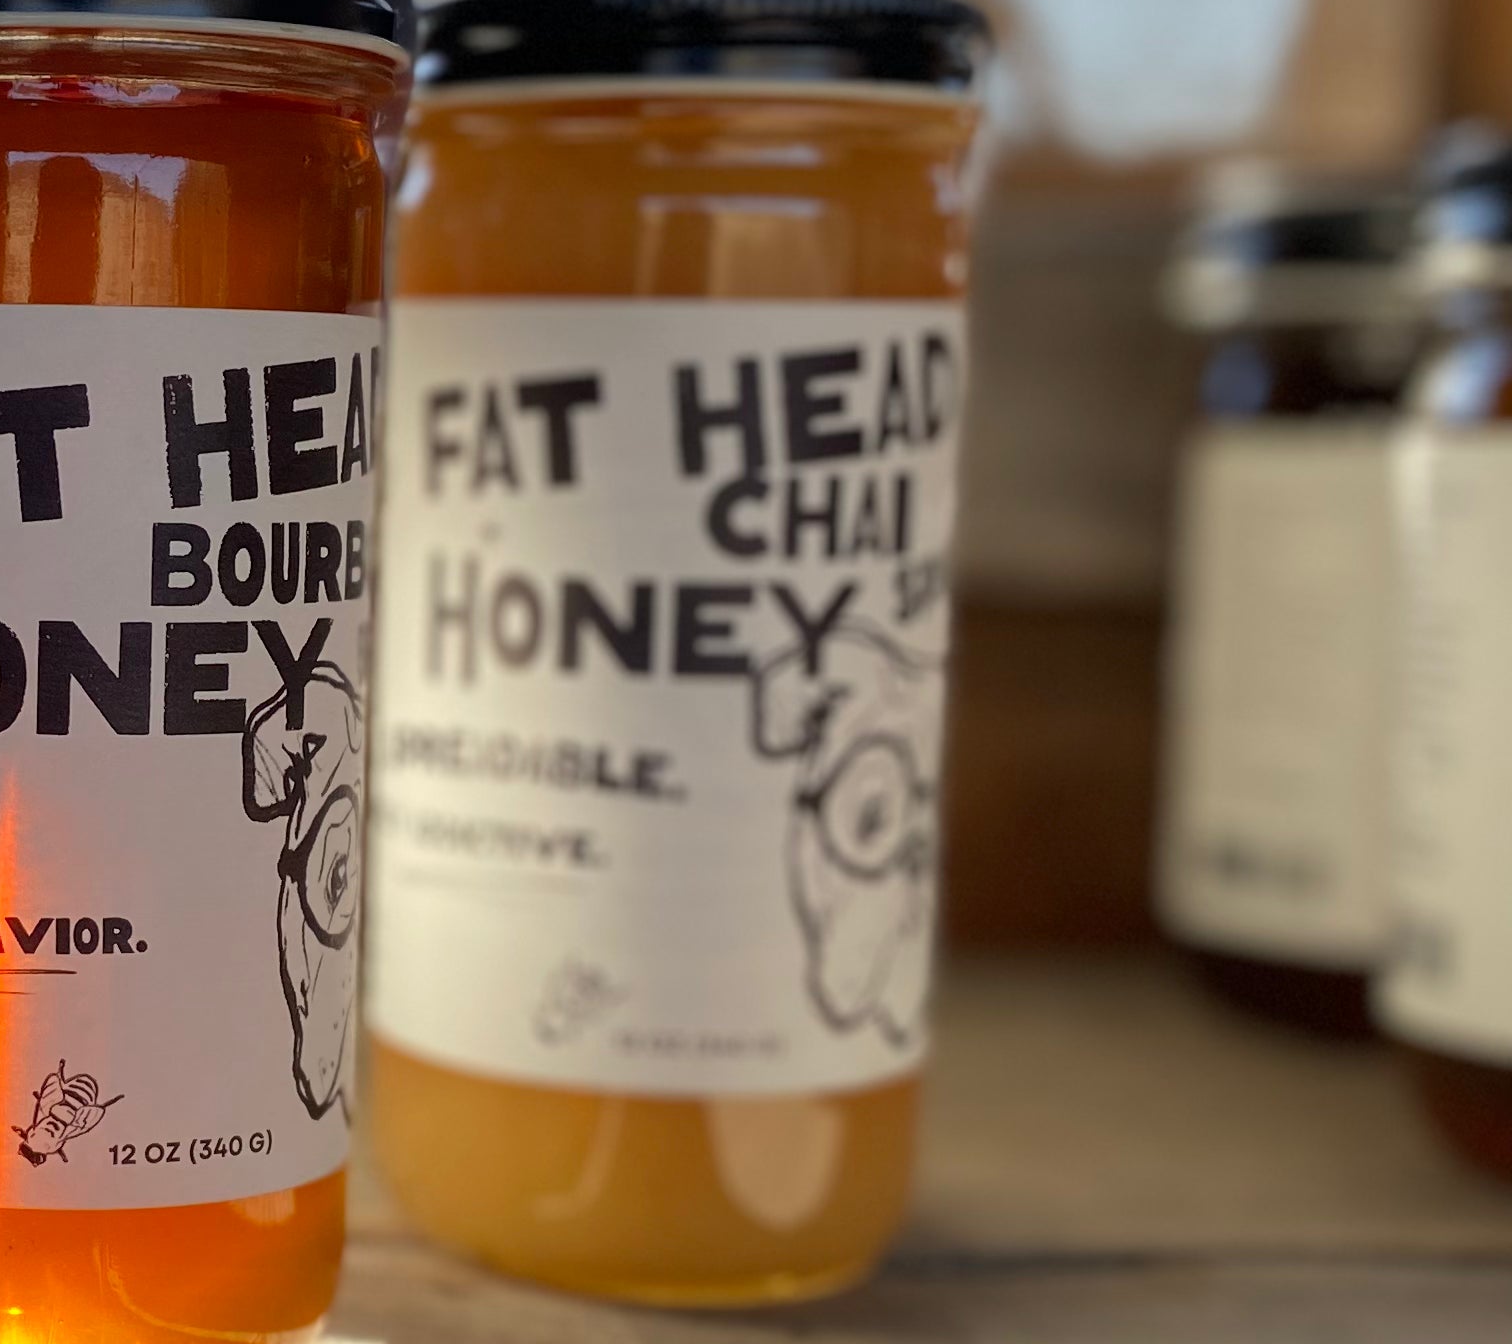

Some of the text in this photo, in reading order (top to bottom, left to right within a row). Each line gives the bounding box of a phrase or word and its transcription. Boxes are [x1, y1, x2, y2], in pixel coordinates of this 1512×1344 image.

[162, 345, 378, 510] HEA
[424, 372, 605, 498] FAT
[151, 519, 366, 607] BOURB
[705, 471, 911, 562] CHAI
[424, 552, 858, 686] HONEY
[108, 1128, 273, 1166] 12 OZ (340 G)
